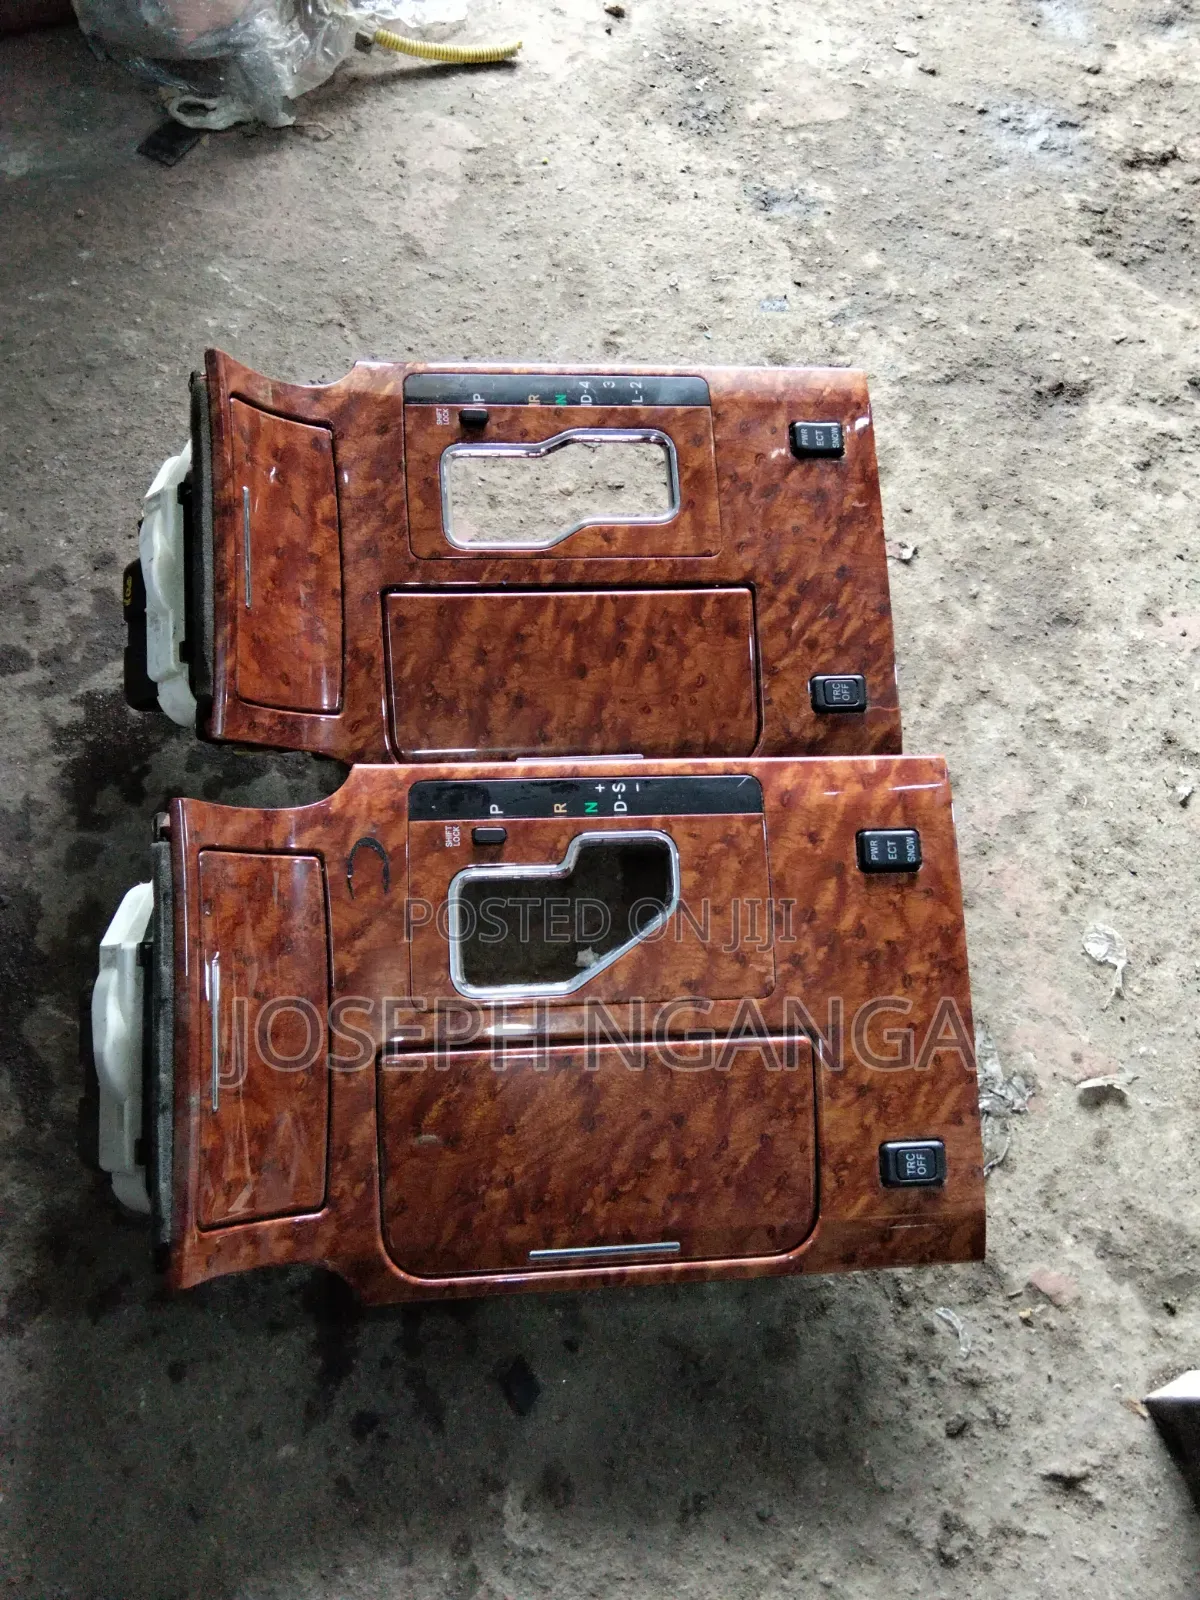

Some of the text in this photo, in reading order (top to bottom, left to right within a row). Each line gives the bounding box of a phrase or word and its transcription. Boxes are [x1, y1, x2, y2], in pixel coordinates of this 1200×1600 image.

[472, 393, 485, 402] P
[528, 394, 540, 403] R
[555, 394, 567, 404] N
[801, 428, 809, 446] PWR
[815, 430, 824, 446] ECT
[831, 426, 840, 448] SNOW
[832, 683, 841, 701] TRC
[841, 683, 850, 701] OFF
[490, 804, 503, 814] P
[554, 803, 567, 813] R
[584, 802, 598, 813] N
[445, 825, 453, 847] SHIFT
[870, 840, 879, 860] PWR
[887, 840, 897, 860] ECT
[906, 836, 916, 862] SNOW
[906, 1153, 916, 1176] TRC
[916, 1153, 927, 1175] OFF
